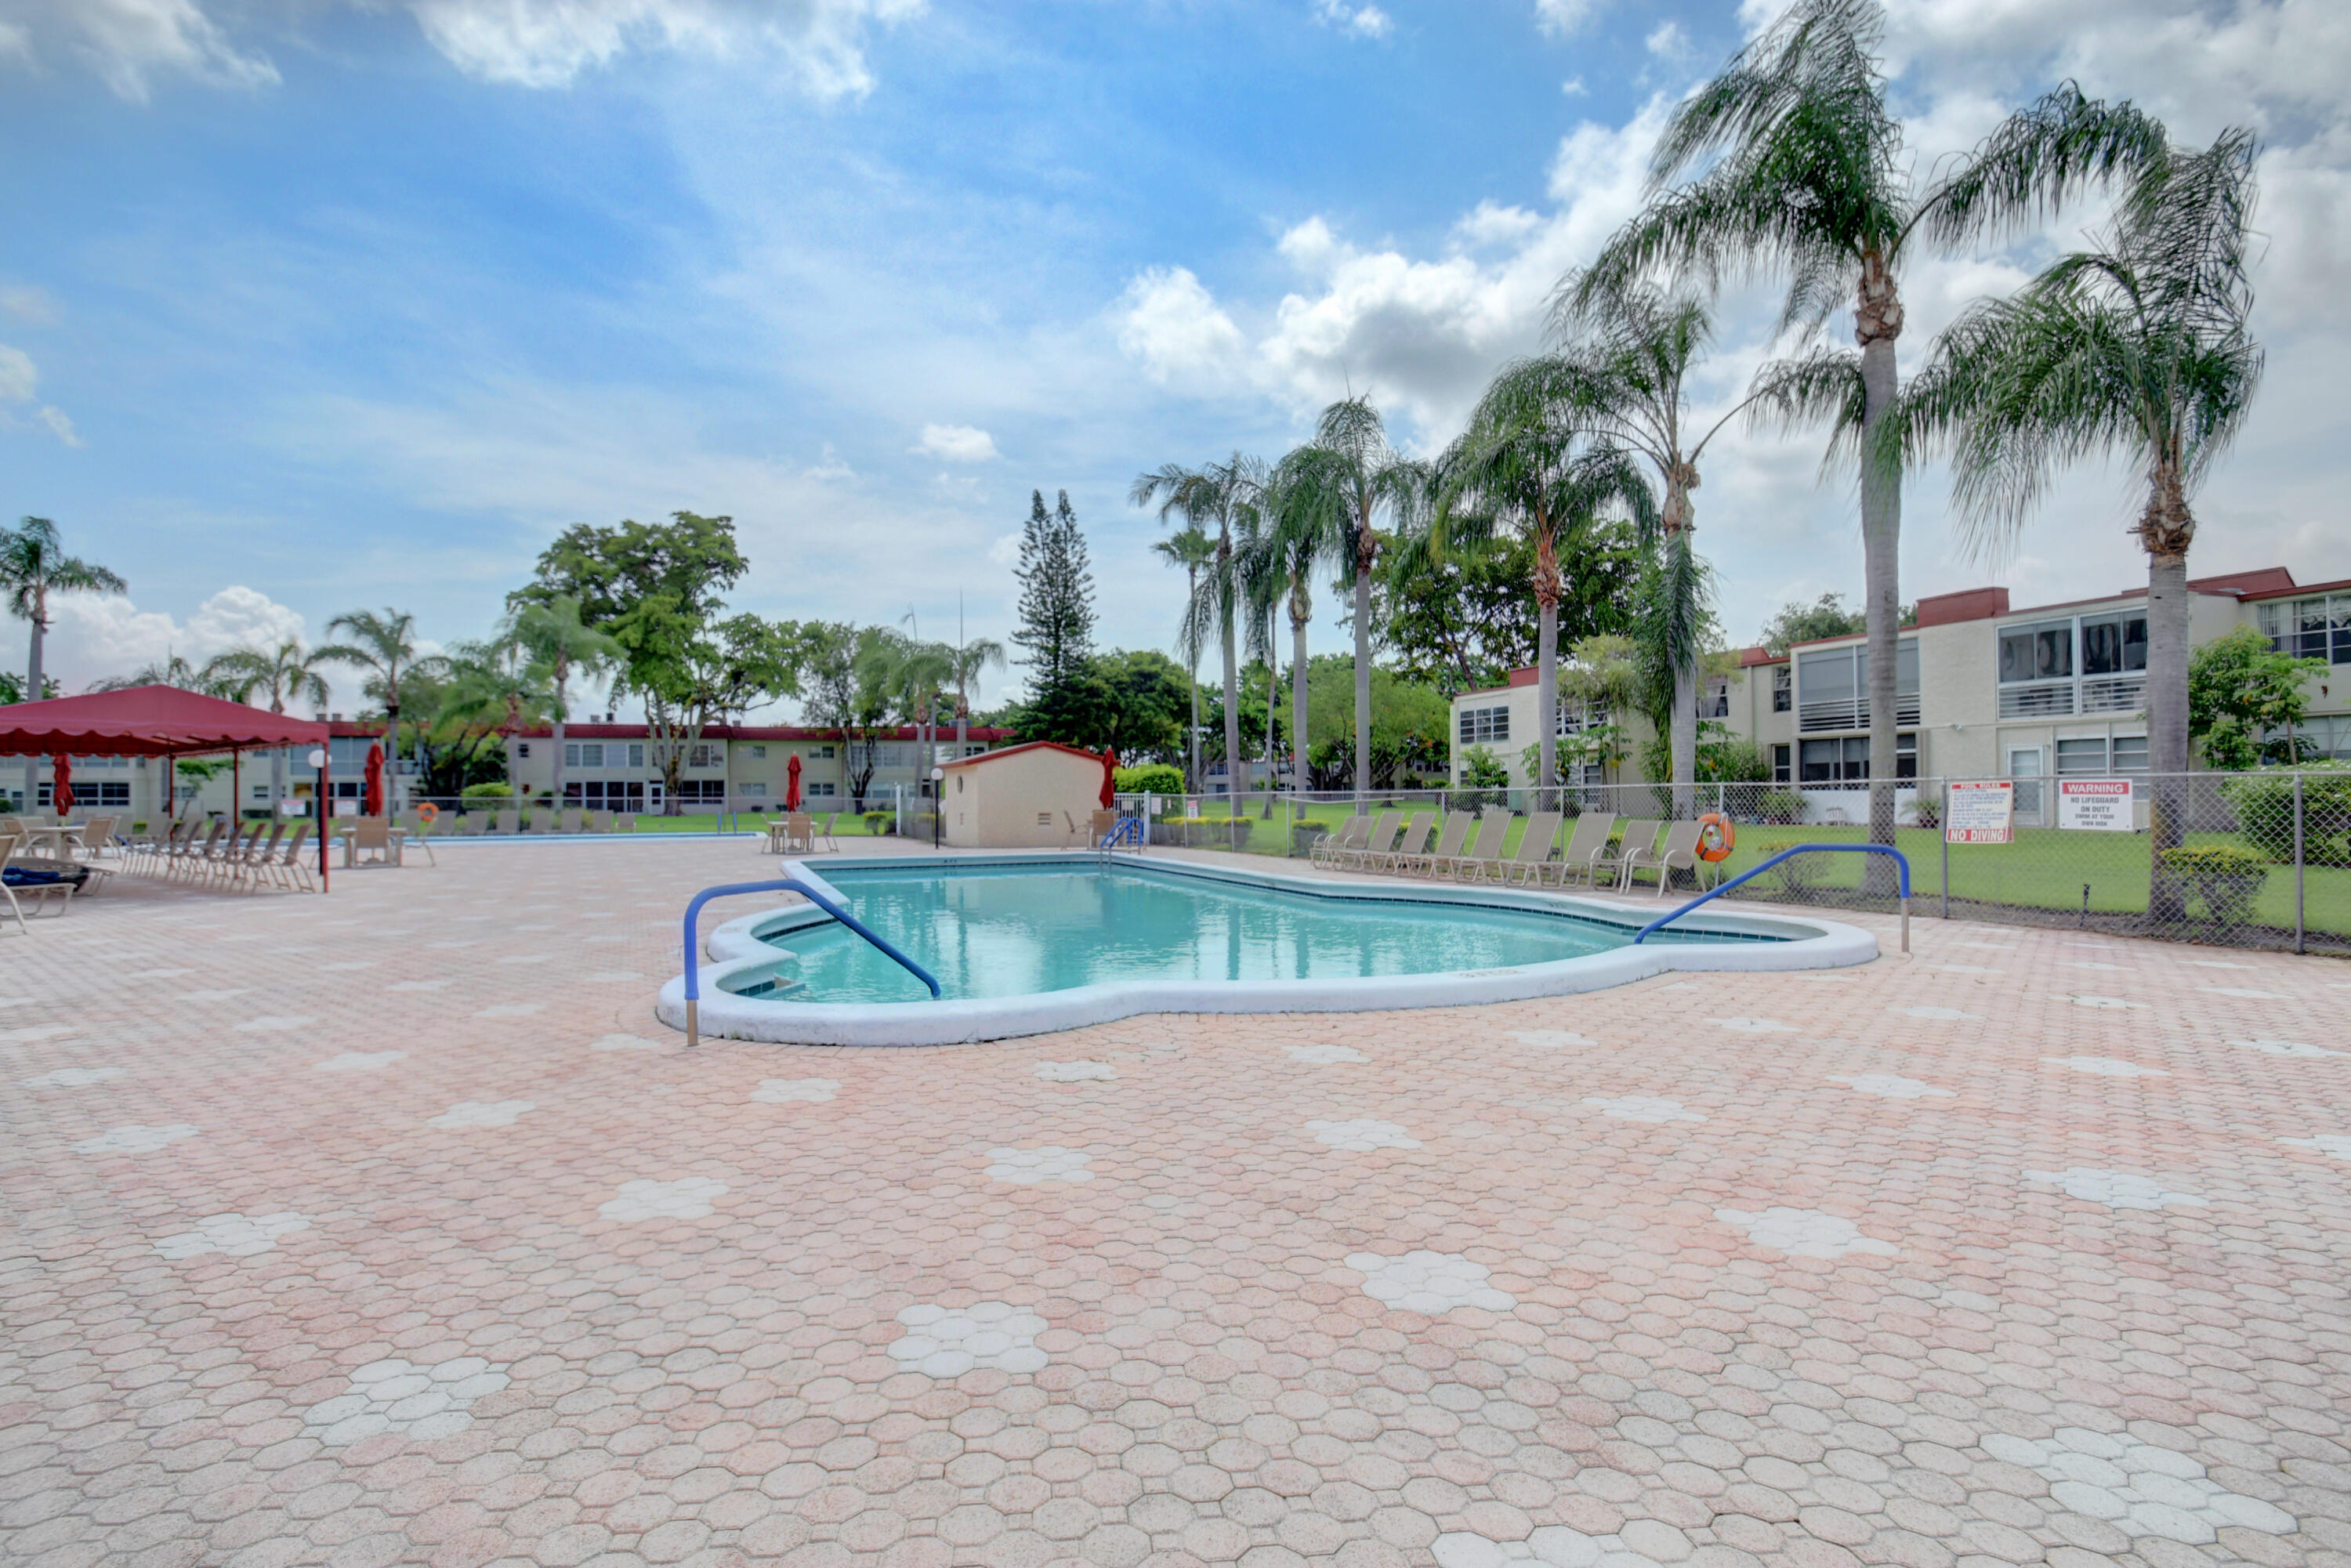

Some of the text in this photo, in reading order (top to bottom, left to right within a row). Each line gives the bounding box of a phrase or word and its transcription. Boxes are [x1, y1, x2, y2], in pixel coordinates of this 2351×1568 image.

[2067, 784, 2124, 793] WARNING
[1951, 829, 2003, 841] NO DIVING
